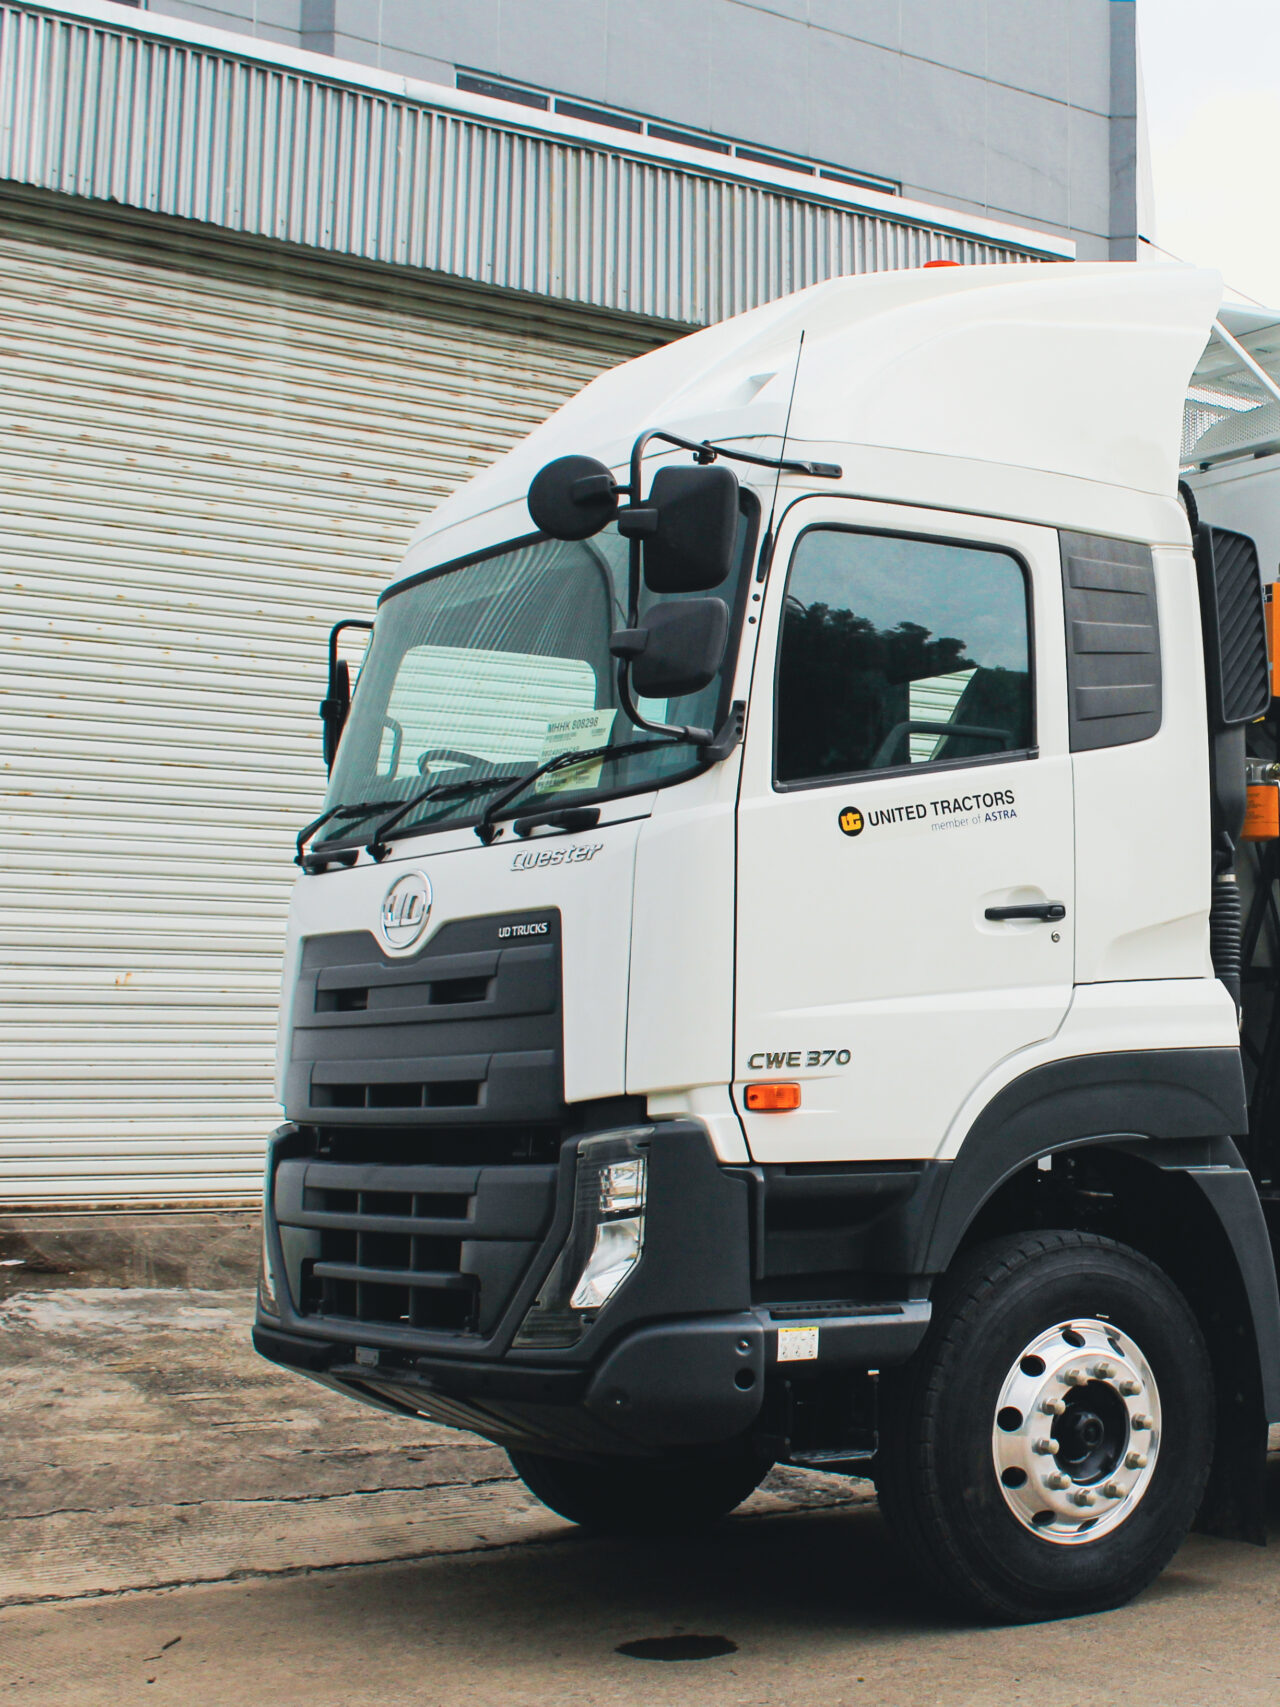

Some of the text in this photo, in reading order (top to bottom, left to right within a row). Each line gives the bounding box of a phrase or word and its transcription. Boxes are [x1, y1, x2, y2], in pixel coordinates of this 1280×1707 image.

[868, 789, 1015, 827] UNITED TRACTORS
[931, 808, 1017, 832] member of ASTRA
[510, 843, 604, 871] Quester
[498, 922, 548, 938] UD TRUCKS
[748, 1048, 852, 1070] CWE 370
